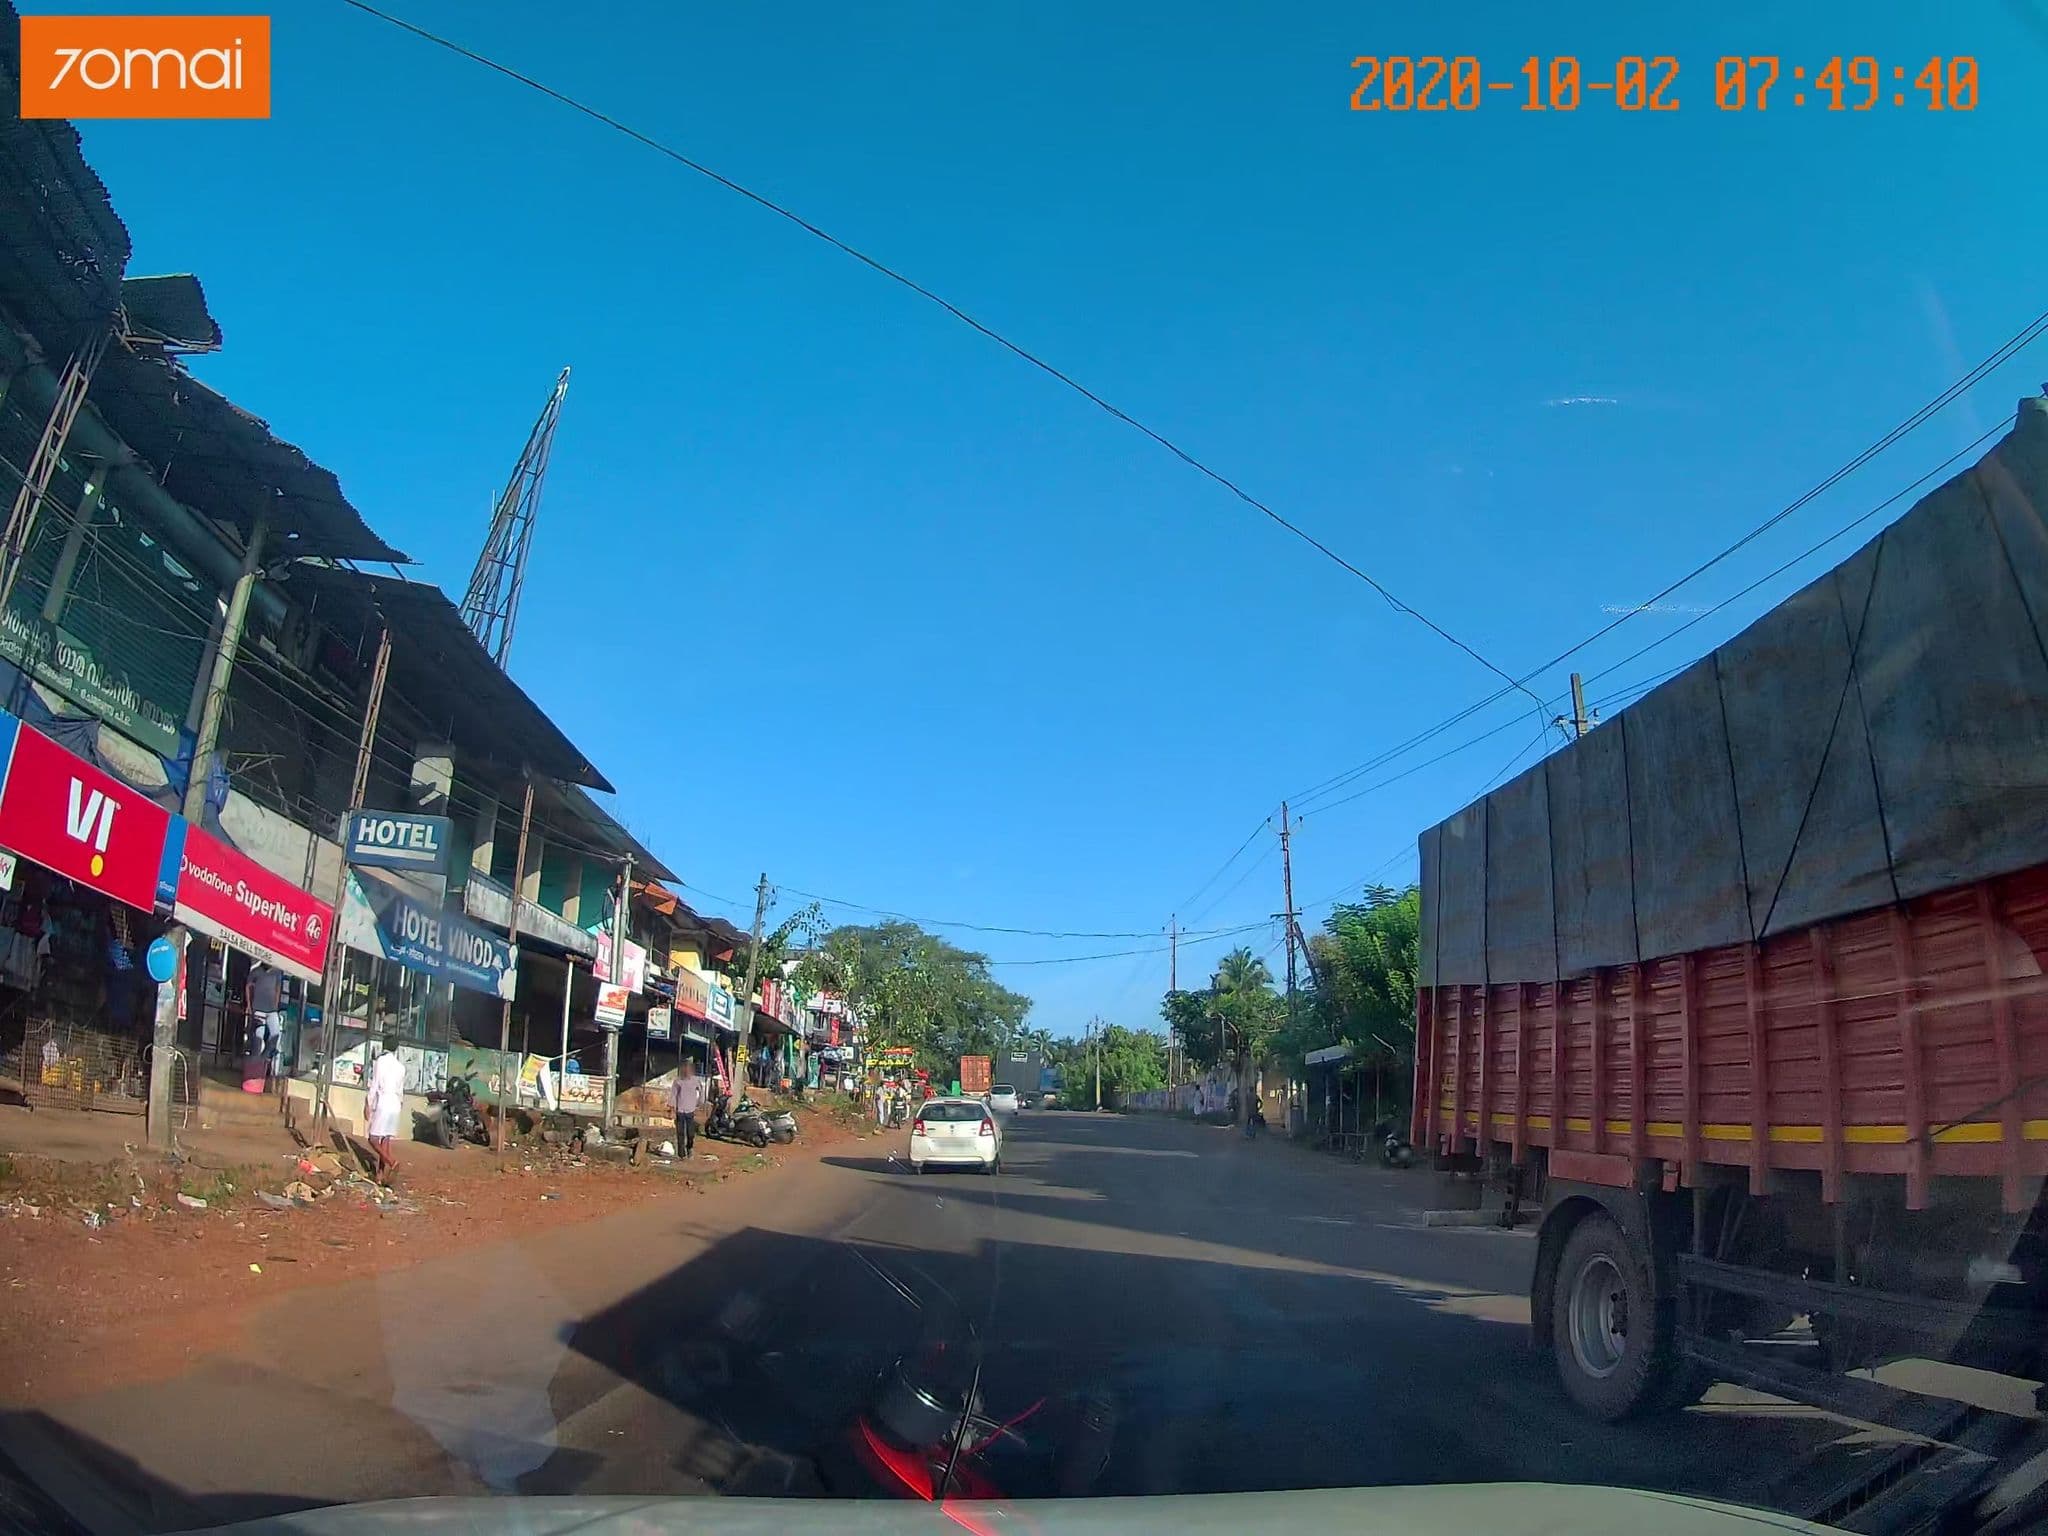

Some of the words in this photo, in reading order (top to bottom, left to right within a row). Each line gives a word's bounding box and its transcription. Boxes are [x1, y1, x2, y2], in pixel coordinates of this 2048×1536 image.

[358, 817, 439, 851] HOTEL
[188, 861, 233, 897] vodafone
[235, 879, 298, 932] SuperNet
[306, 916, 322, 939] 4G
[393, 902, 443, 952] HOTEL
[449, 926, 493, 969] VINOD
